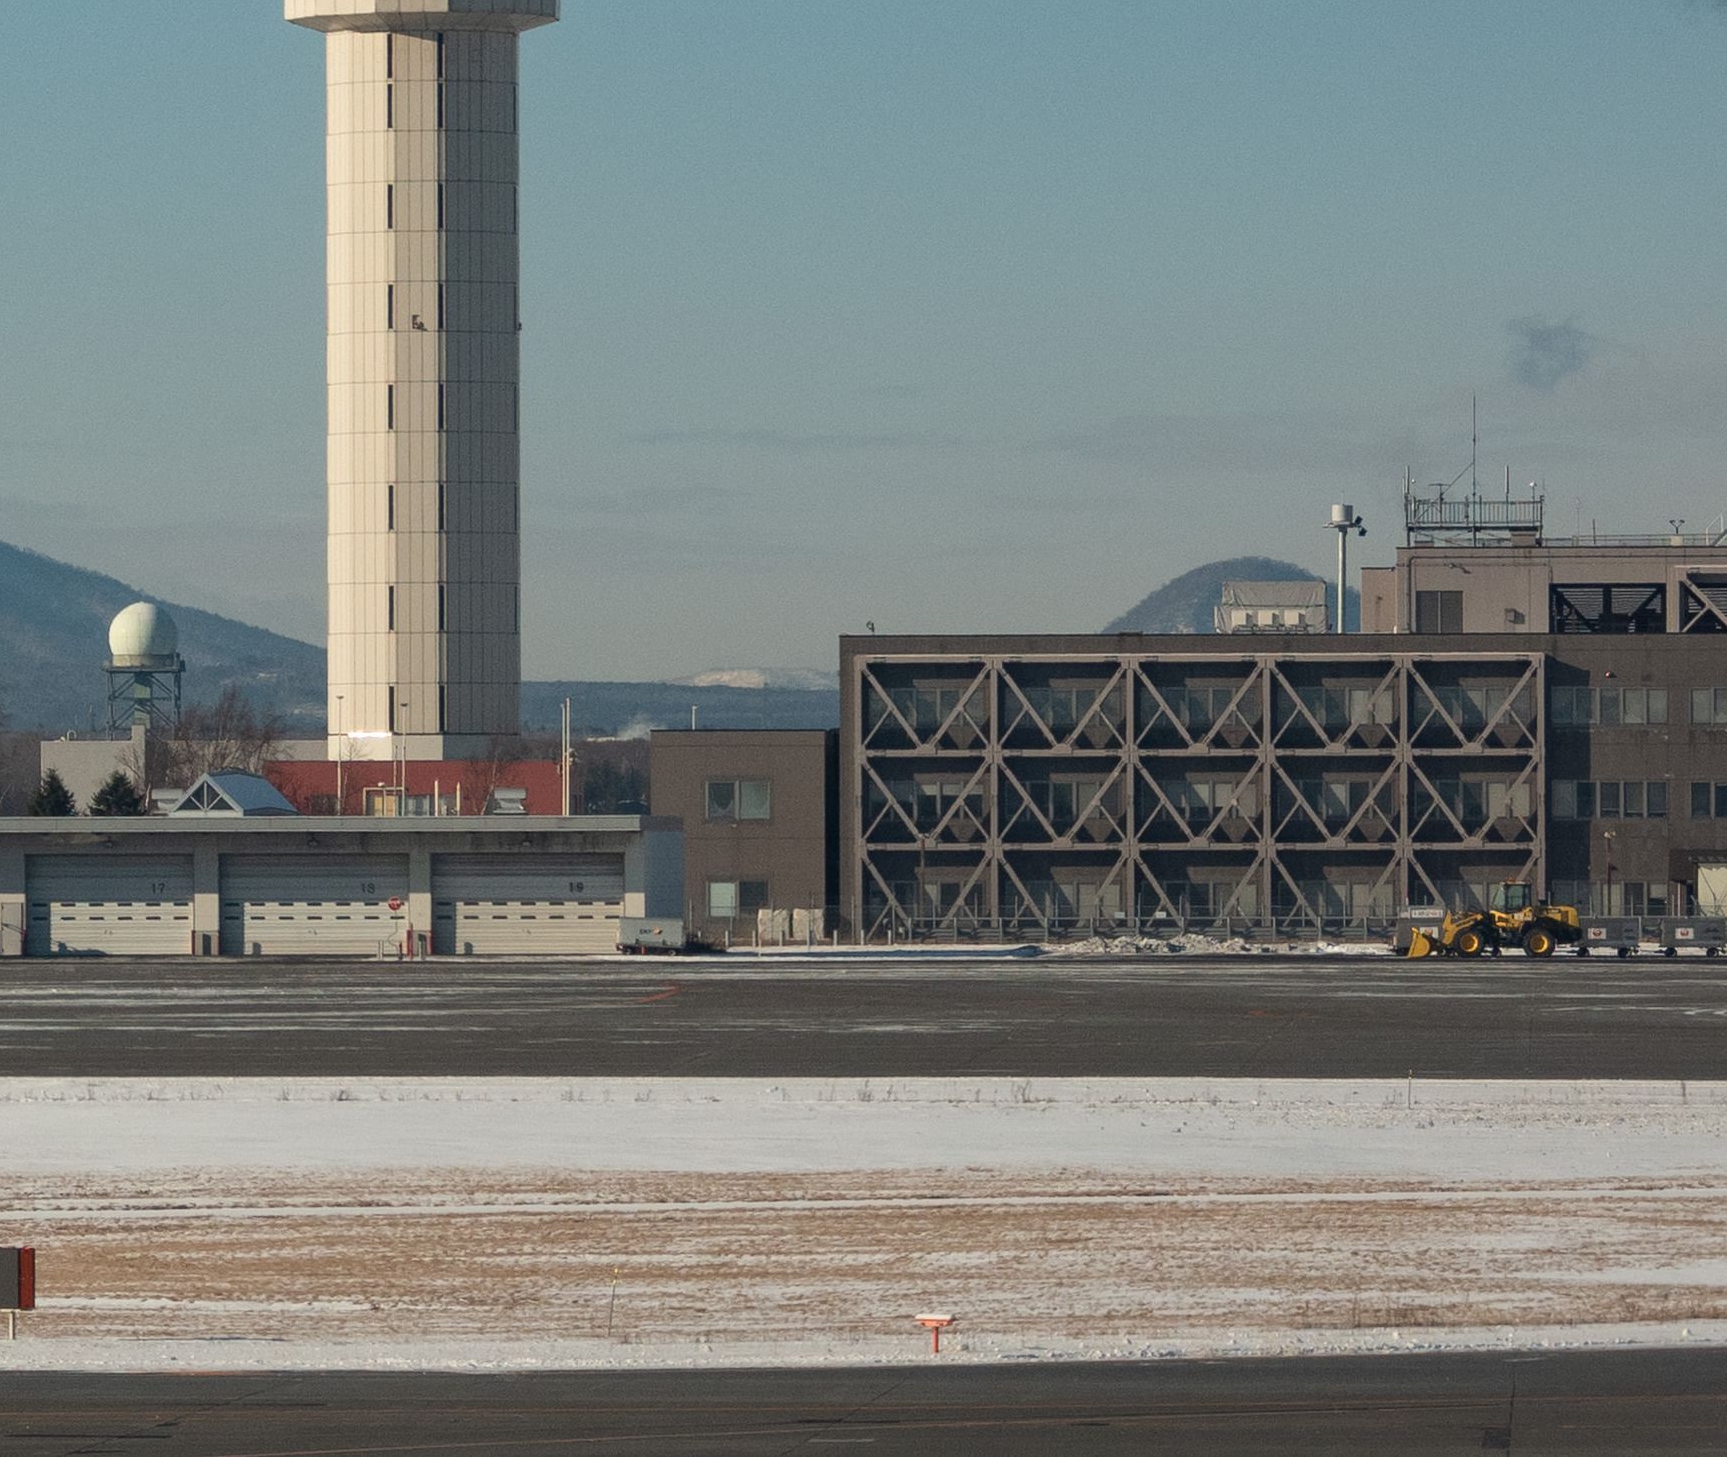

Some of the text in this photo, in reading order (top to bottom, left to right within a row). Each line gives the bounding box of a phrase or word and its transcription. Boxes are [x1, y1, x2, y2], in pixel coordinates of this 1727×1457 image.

[152, 883, 166, 894] 17
[361, 882, 375, 894] 18
[569, 882, 584, 893] 19
